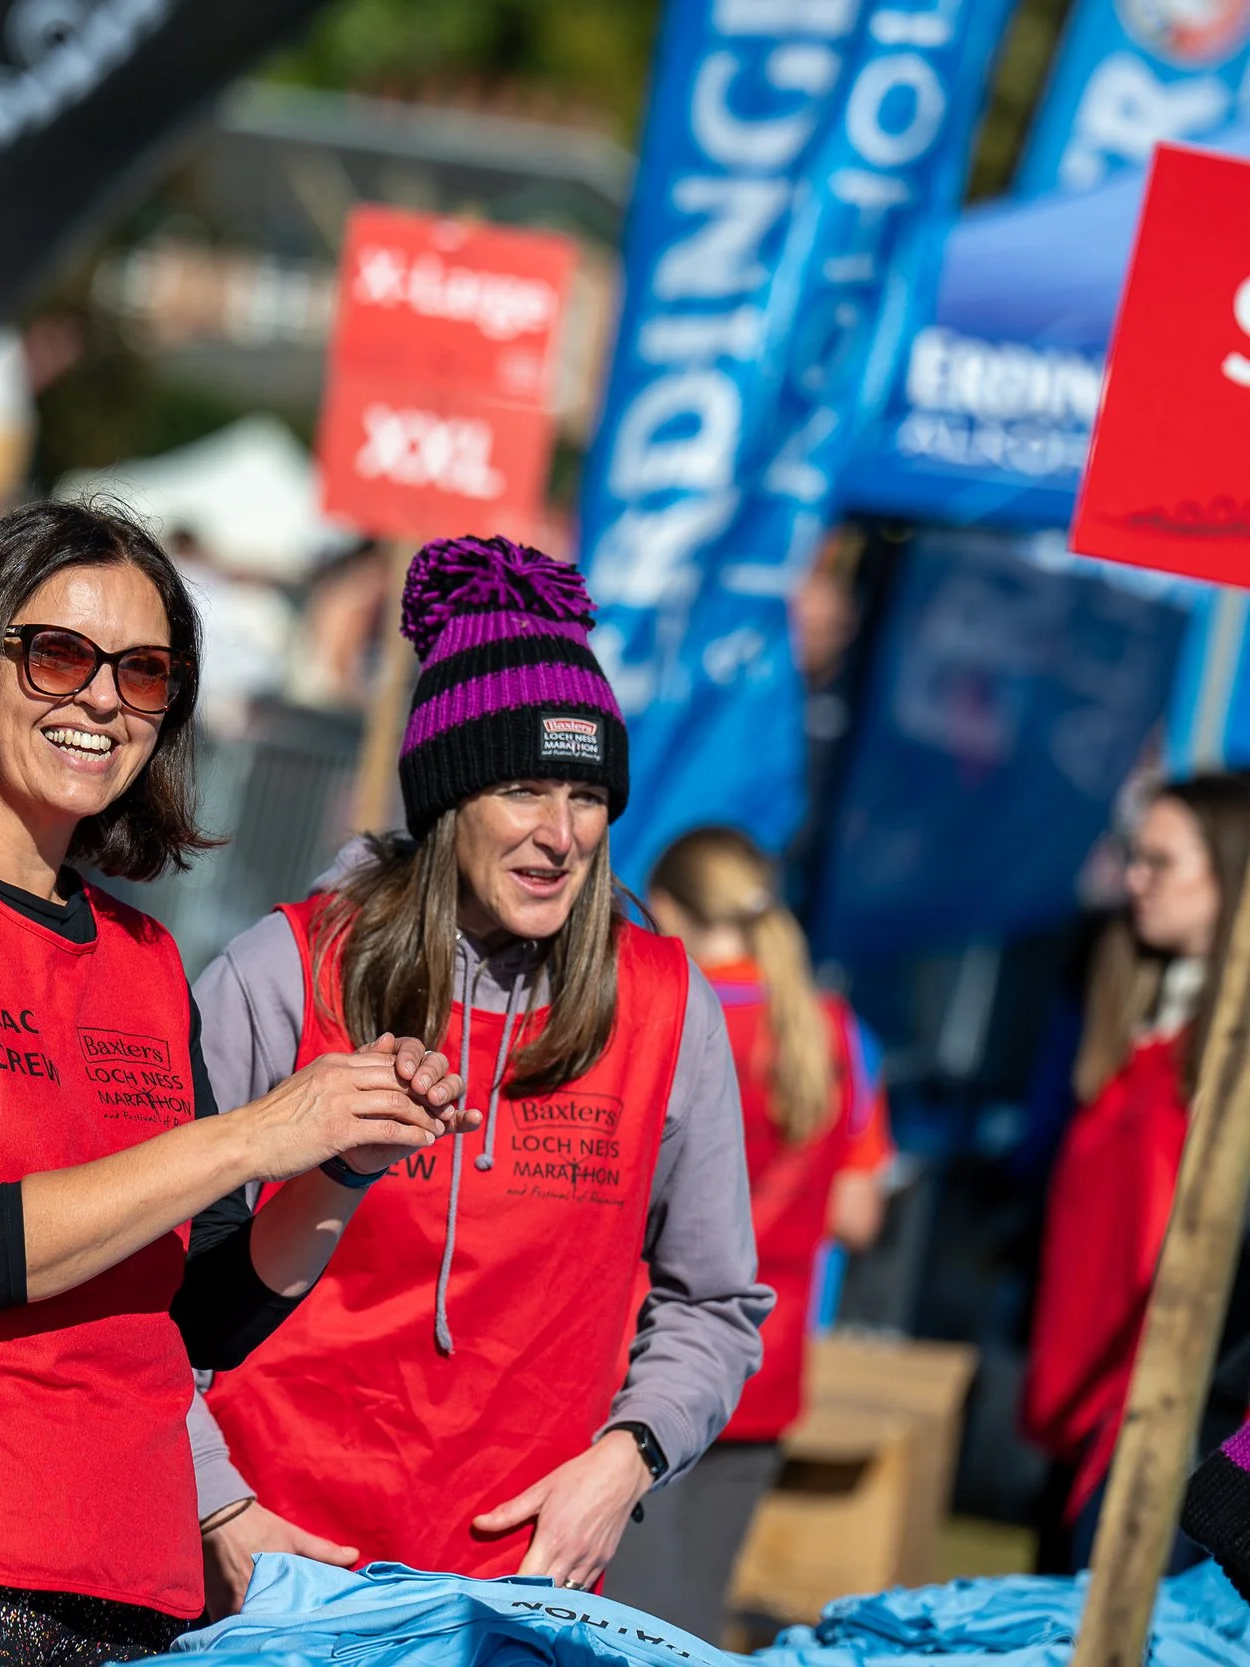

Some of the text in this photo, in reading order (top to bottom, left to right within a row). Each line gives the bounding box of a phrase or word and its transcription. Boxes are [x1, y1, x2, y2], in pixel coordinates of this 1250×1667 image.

[353, 402, 507, 500] XXL
[544, 732, 597, 744] LOCH NESS
[549, 719, 593, 733] Baxters
[544, 741, 598, 753] MARATHON
[83, 1036, 164, 1063] Baxters
[85, 1067, 184, 1090] LOCH NESS
[98, 1090, 192, 1116] MARATHON
[520, 1100, 618, 1127] Baxters
[512, 1135, 571, 1153] LOCH
[513, 1160, 620, 1186] MARATHON
